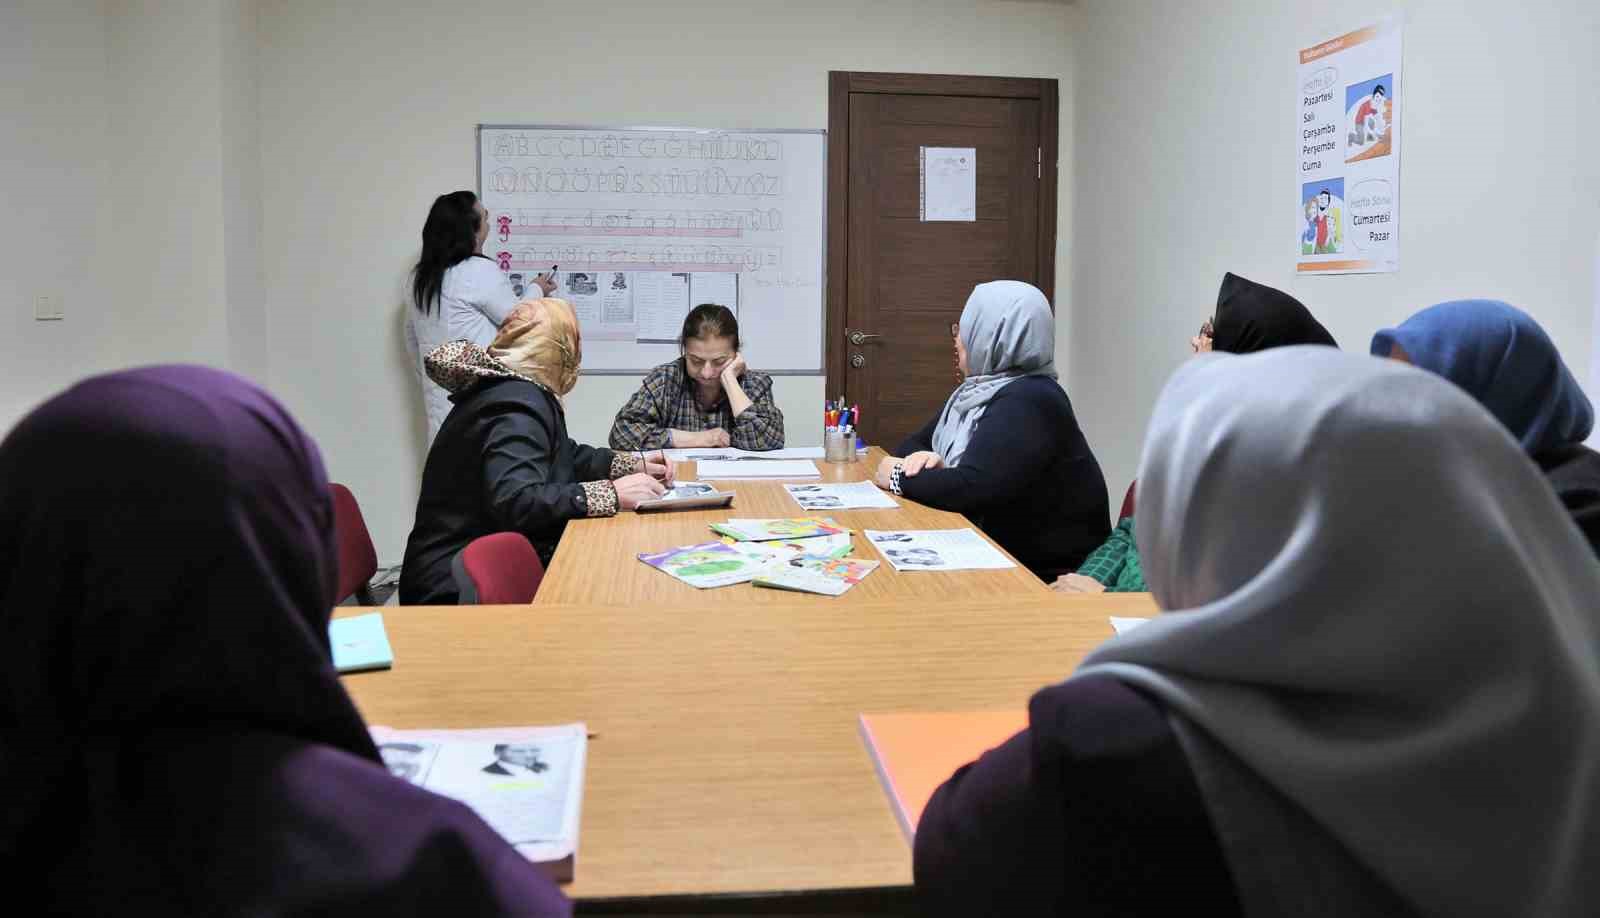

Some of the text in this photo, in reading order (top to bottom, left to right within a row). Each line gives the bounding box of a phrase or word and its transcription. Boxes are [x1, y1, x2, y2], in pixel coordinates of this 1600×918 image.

[1304, 91, 1333, 106] Pazartesi
[1304, 124, 1335, 141] Çarşamba
[1303, 141, 1335, 154] Perşembe
[1303, 160, 1321, 171] Cuma
[1354, 211, 1391, 225] Cumartesi
[1369, 231, 1390, 241] Pazar
